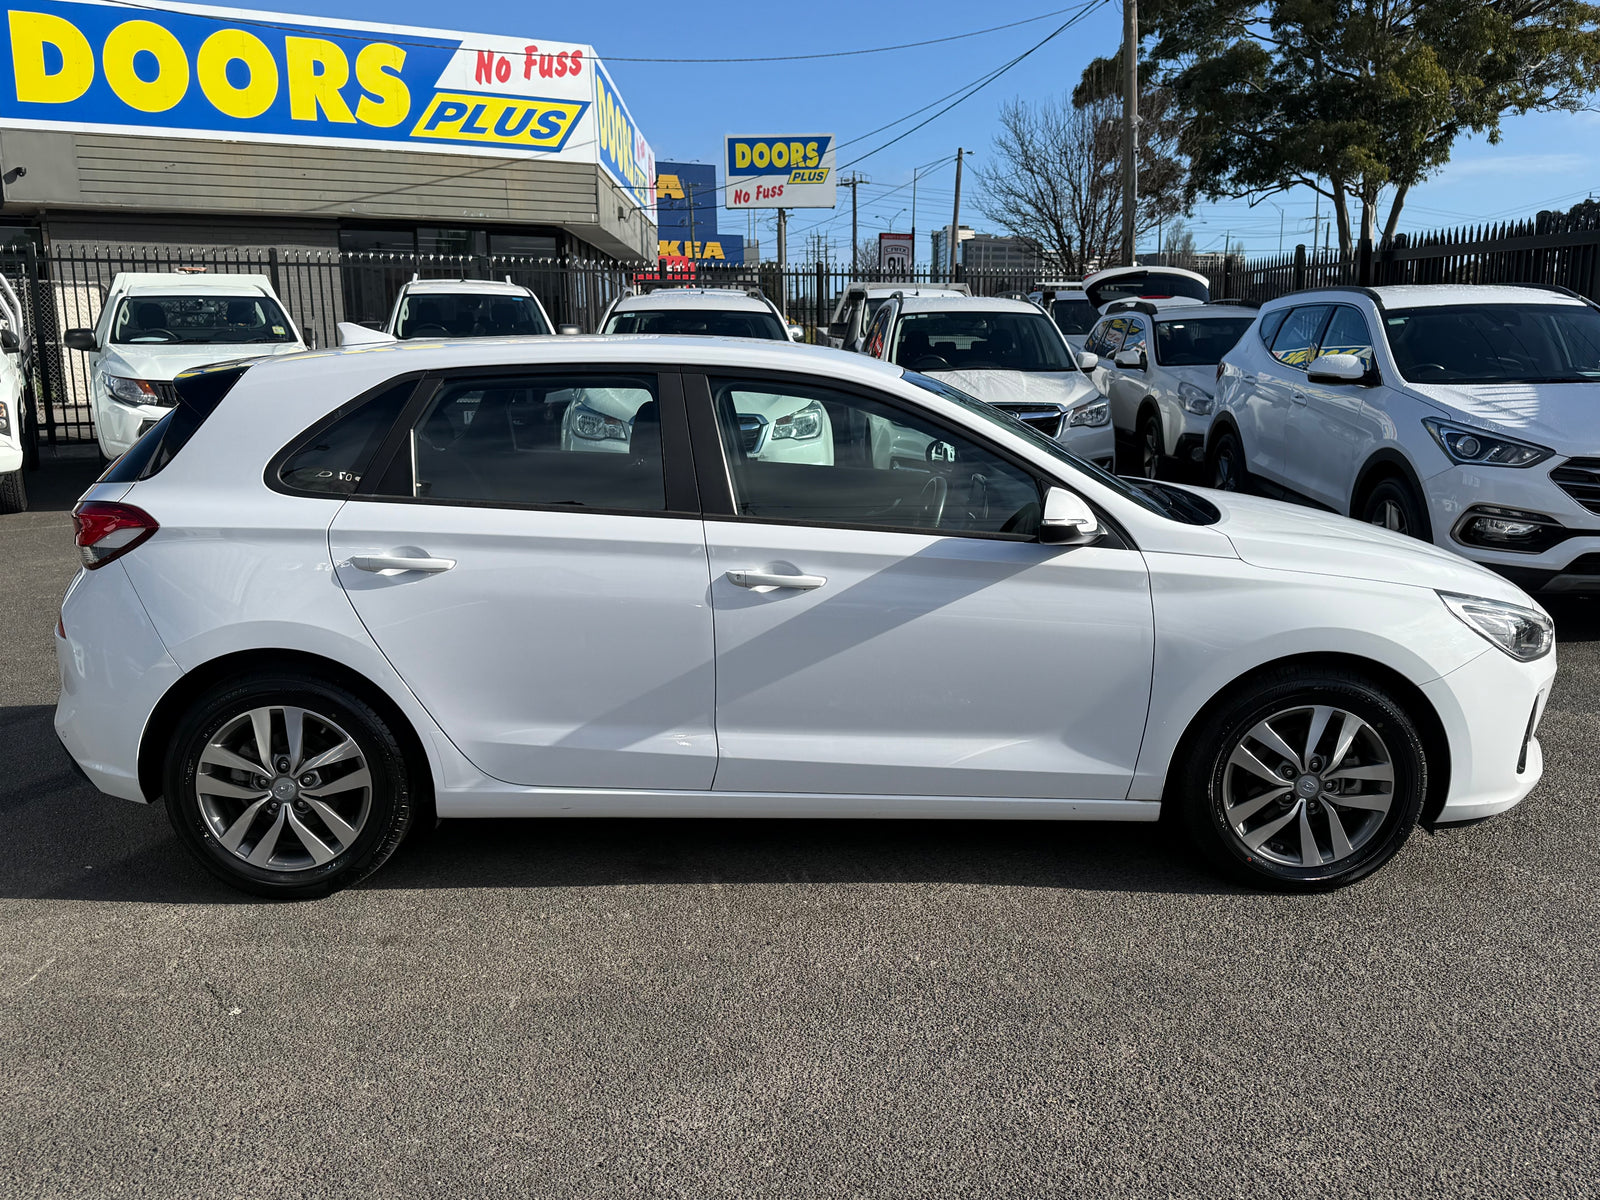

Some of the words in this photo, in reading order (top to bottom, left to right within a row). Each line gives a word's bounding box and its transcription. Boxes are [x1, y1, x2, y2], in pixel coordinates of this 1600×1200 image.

[8, 9, 411, 128] DOORS
[475, 49, 511, 85] No
[524, 45, 583, 80] Fuss
[423, 101, 568, 140] PLUS
[597, 74, 634, 187] DOORS
[735, 141, 819, 169] DOORS
[734, 189, 750, 205] No
[756, 184, 784, 201] Fuss
[792, 171, 824, 182] PLUS
